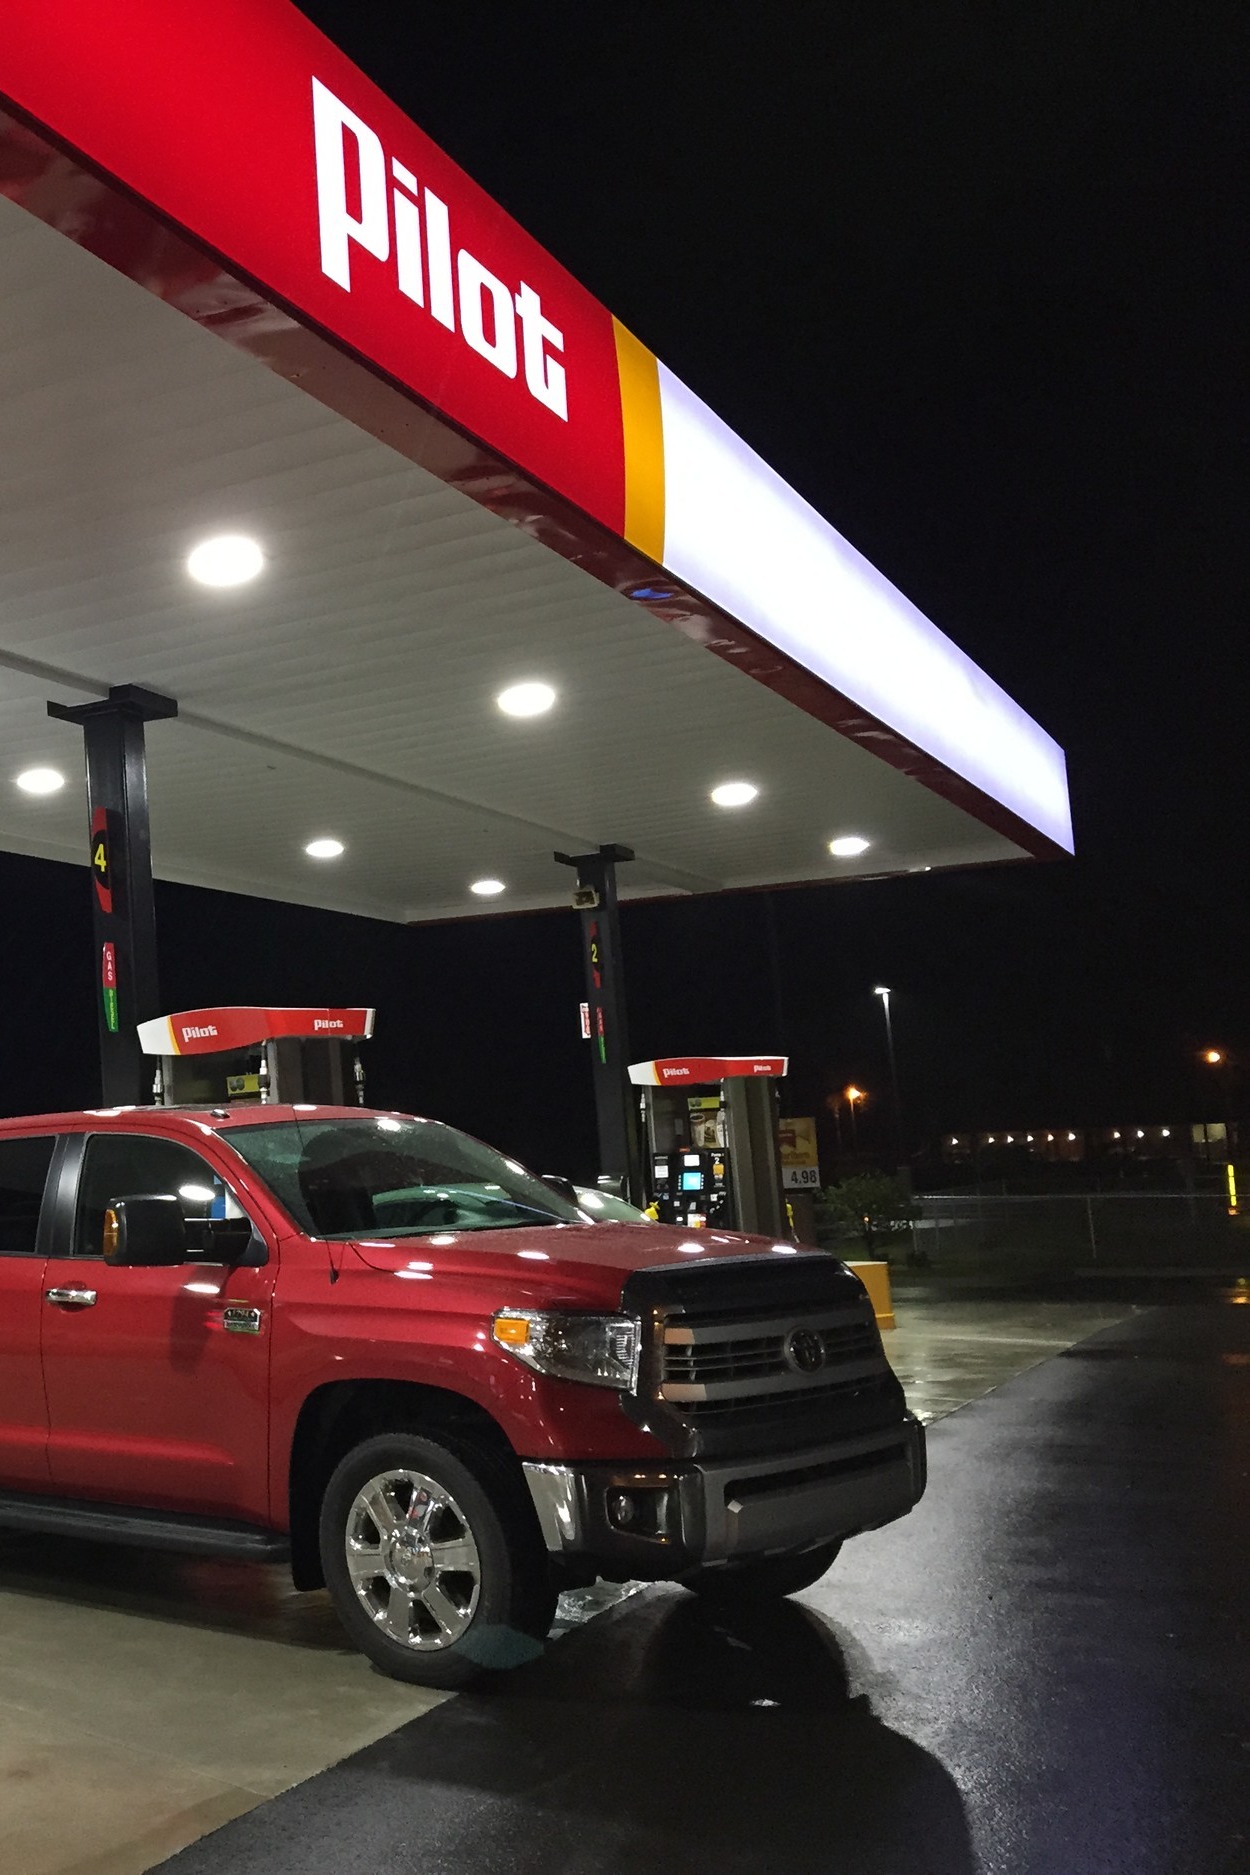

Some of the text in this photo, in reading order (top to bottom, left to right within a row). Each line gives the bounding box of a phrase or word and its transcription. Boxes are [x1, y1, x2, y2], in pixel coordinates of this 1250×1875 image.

[312, 75, 569, 422] Pilot
[94, 843, 107, 872] 4
[591, 943, 598, 963] 2
[181, 1024, 218, 1043] Pilot
[313, 1018, 344, 1031] Pilot
[662, 1066, 690, 1078] Pilot
[791, 1169, 817, 1184] 4.98
